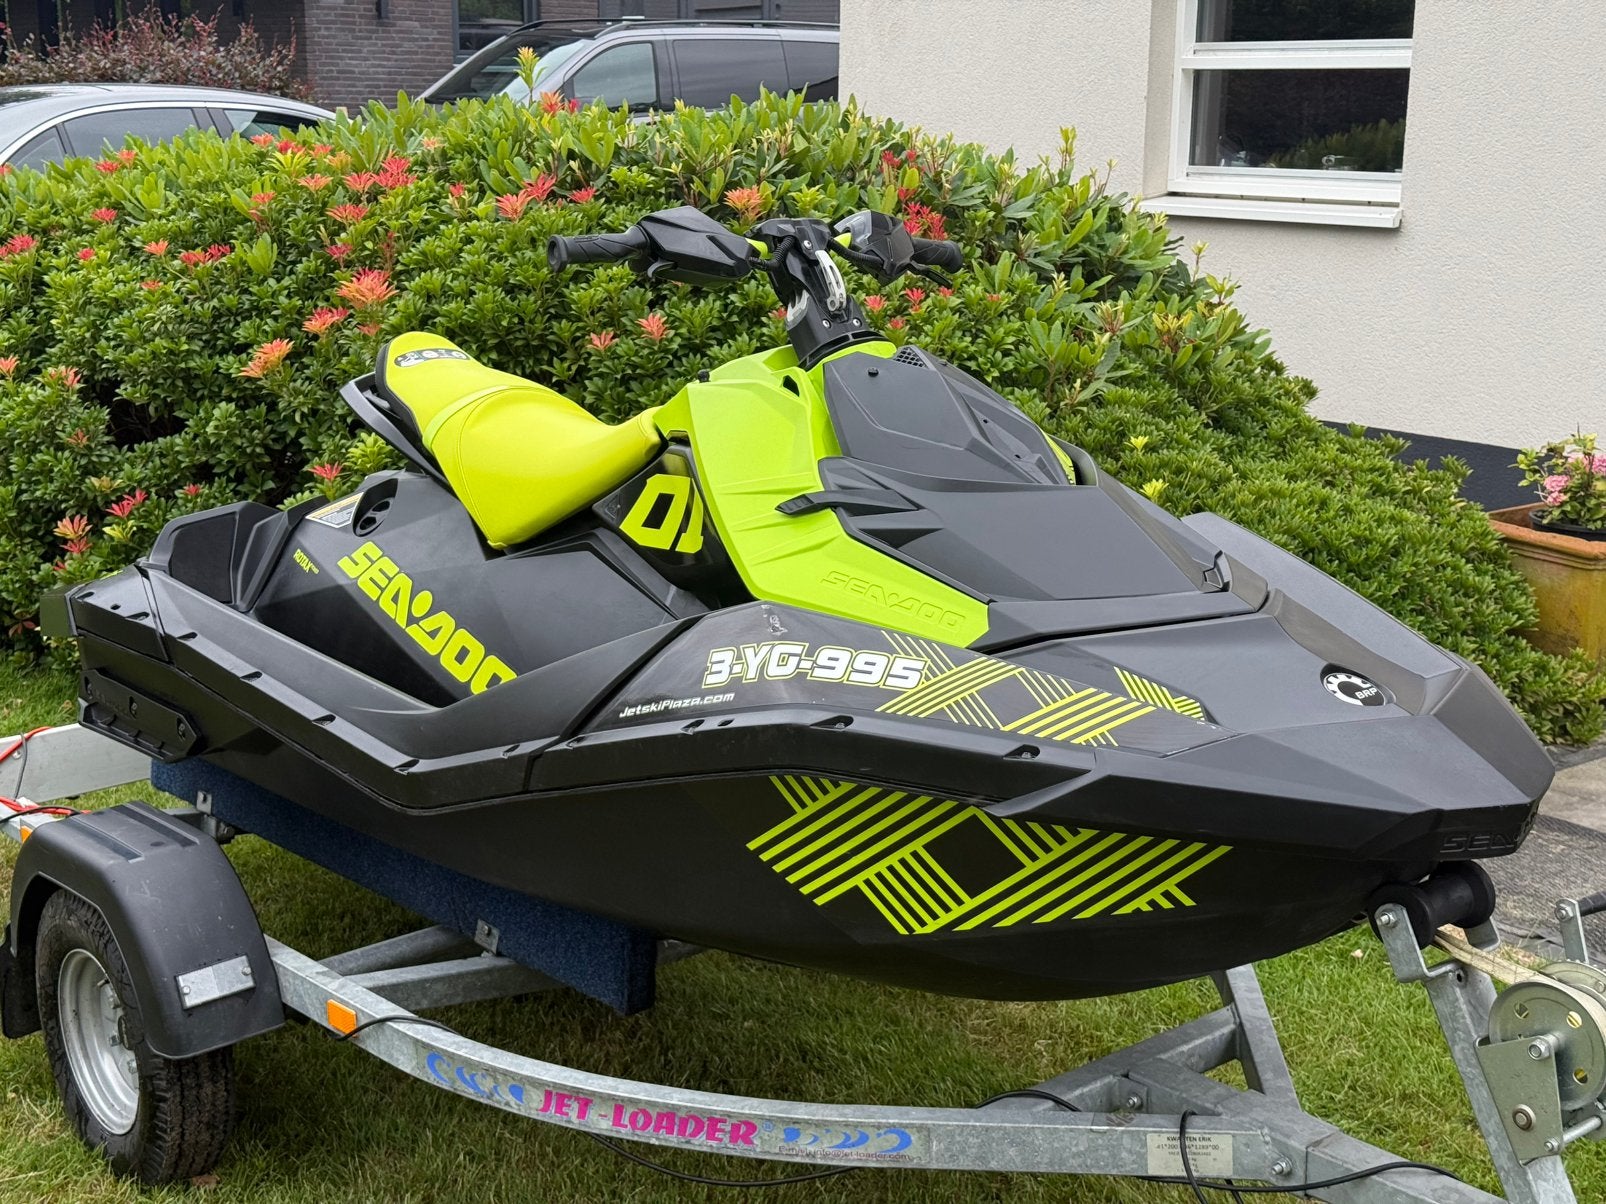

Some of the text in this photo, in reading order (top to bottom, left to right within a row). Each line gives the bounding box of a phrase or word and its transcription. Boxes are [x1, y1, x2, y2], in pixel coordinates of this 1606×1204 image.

[702, 641, 931, 690] 3-YG-995
[619, 692, 735, 718] JetskiPlaza.com
[1355, 687, 1378, 699] BRP
